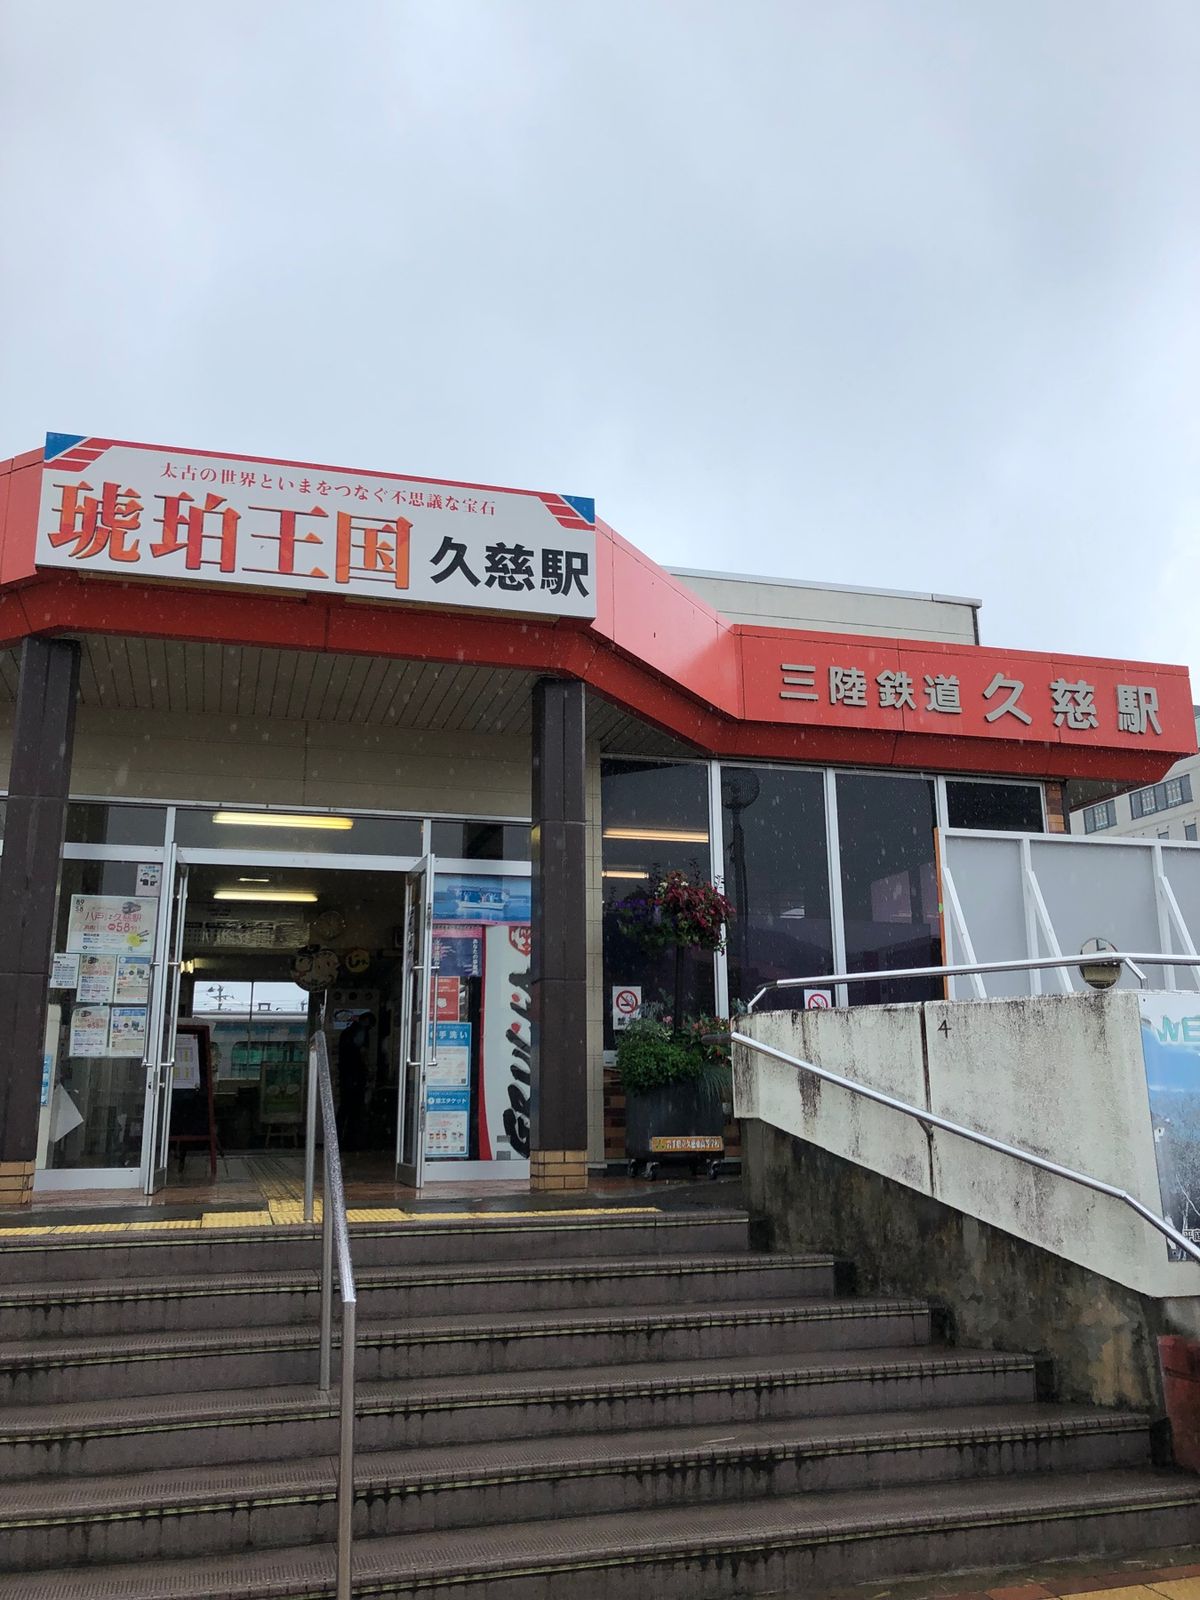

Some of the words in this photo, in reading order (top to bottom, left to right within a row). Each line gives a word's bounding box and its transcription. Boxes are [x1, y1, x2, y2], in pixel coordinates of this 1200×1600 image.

[160, 463, 496, 516] 太古の世界といまをつなぐ不思議な宝石
[48, 481, 414, 590] 琥珀王国
[430, 536, 590, 598] 久慈駅
[780, 663, 963, 715] 三陸鉄道
[983, 672, 1163, 736] 久慈駅
[937, 1019, 952, 1039] 4
